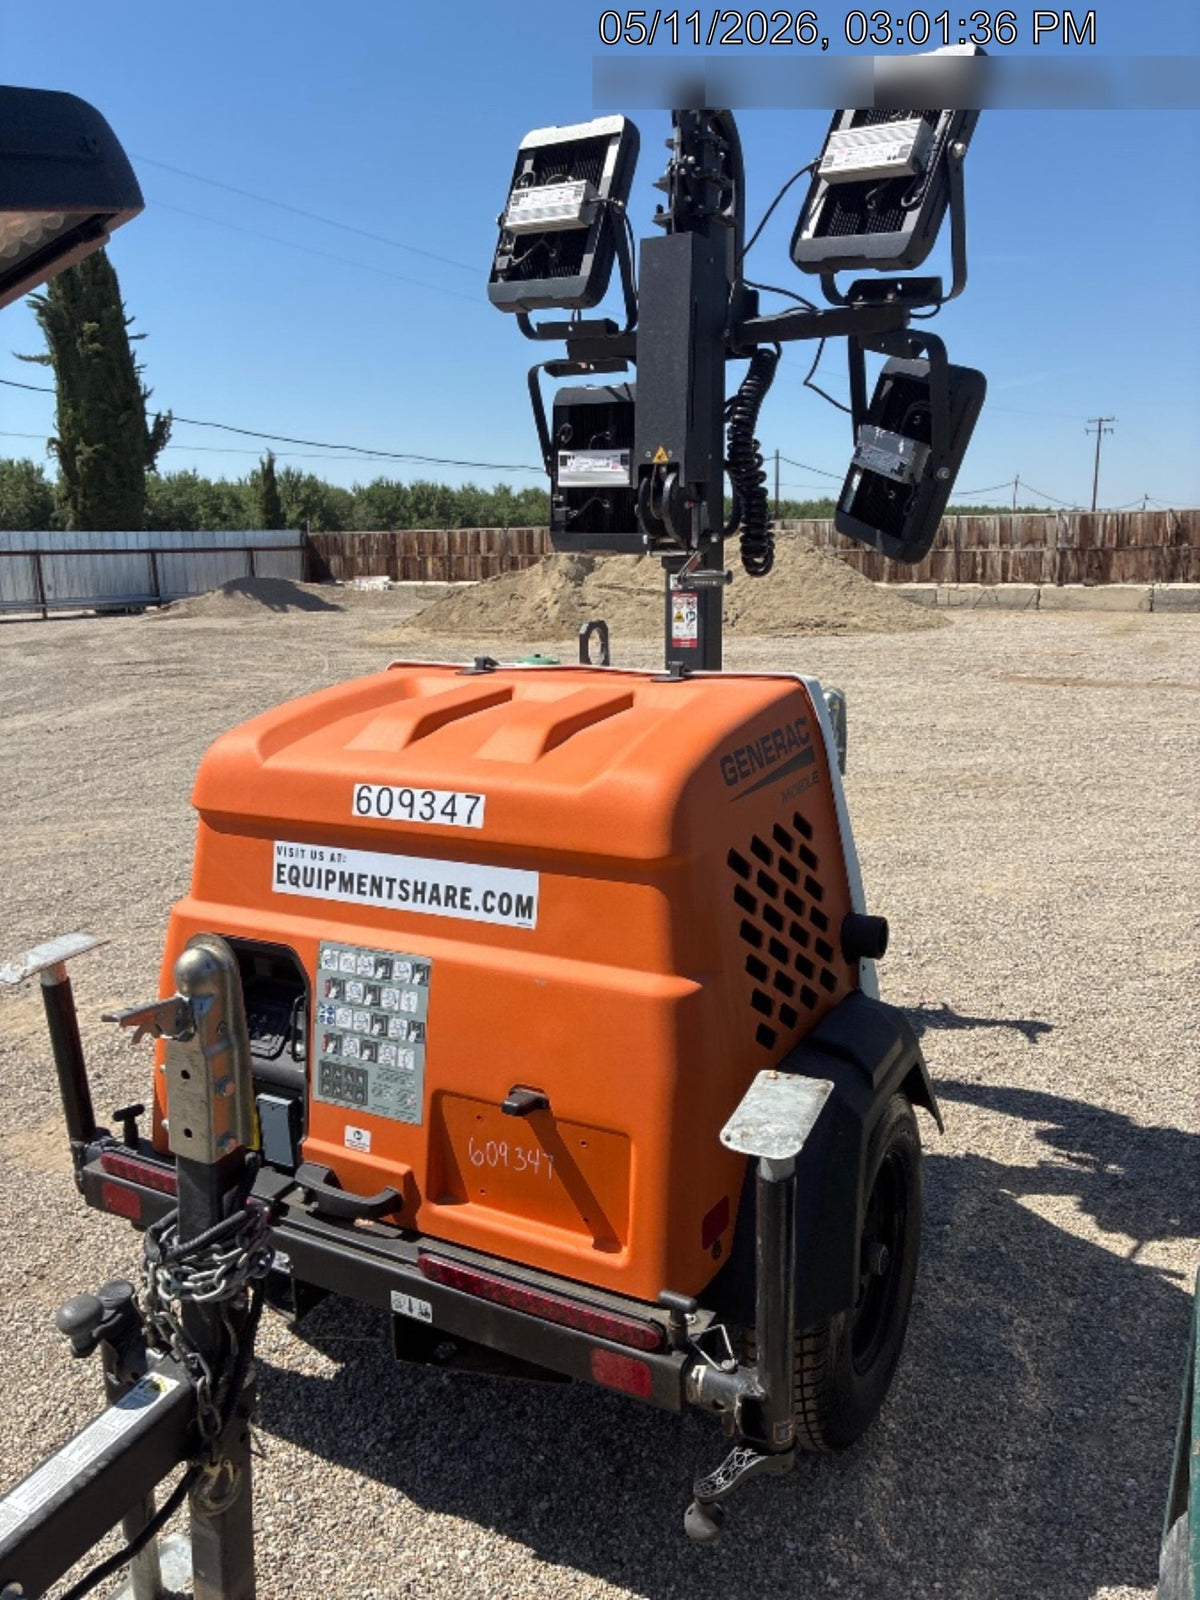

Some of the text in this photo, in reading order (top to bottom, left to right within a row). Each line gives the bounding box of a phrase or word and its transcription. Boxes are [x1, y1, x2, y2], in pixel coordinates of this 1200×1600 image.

[720, 715, 811, 787] GENERAC
[355, 785, 481, 825] 609347
[276, 845, 347, 863] VISIT US AT:
[276, 862, 535, 920] EQUIPMENTSHARE.COM
[468, 1137, 554, 1180] 609347
